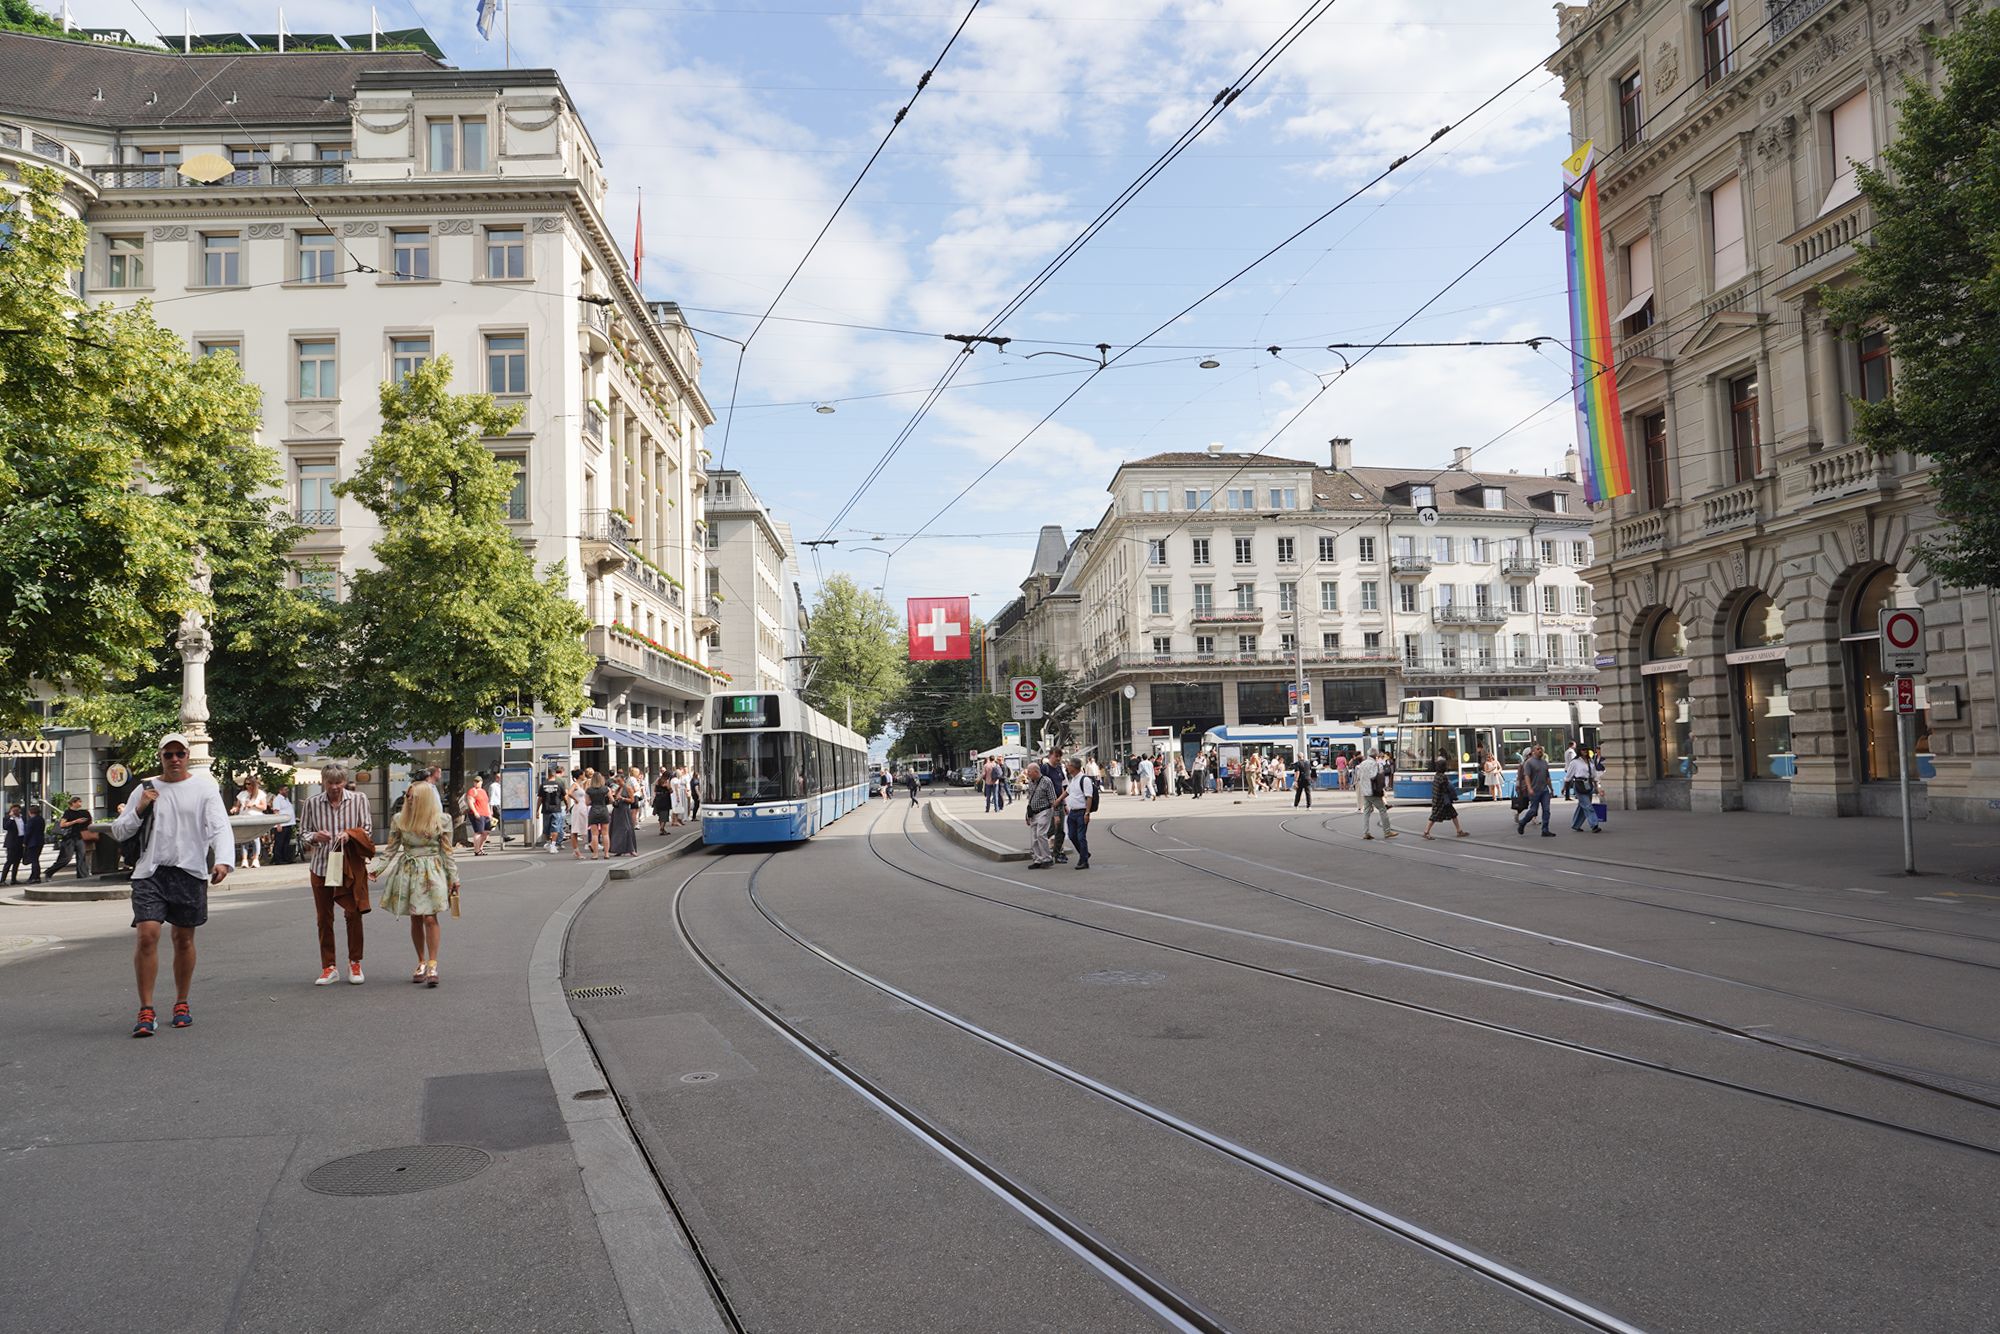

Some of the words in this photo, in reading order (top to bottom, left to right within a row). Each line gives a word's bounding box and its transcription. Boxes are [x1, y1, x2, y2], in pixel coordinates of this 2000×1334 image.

[1423, 513, 1434, 522] 14
[739, 698, 753, 711] 11
[0, 739, 58, 753] SAVOY
